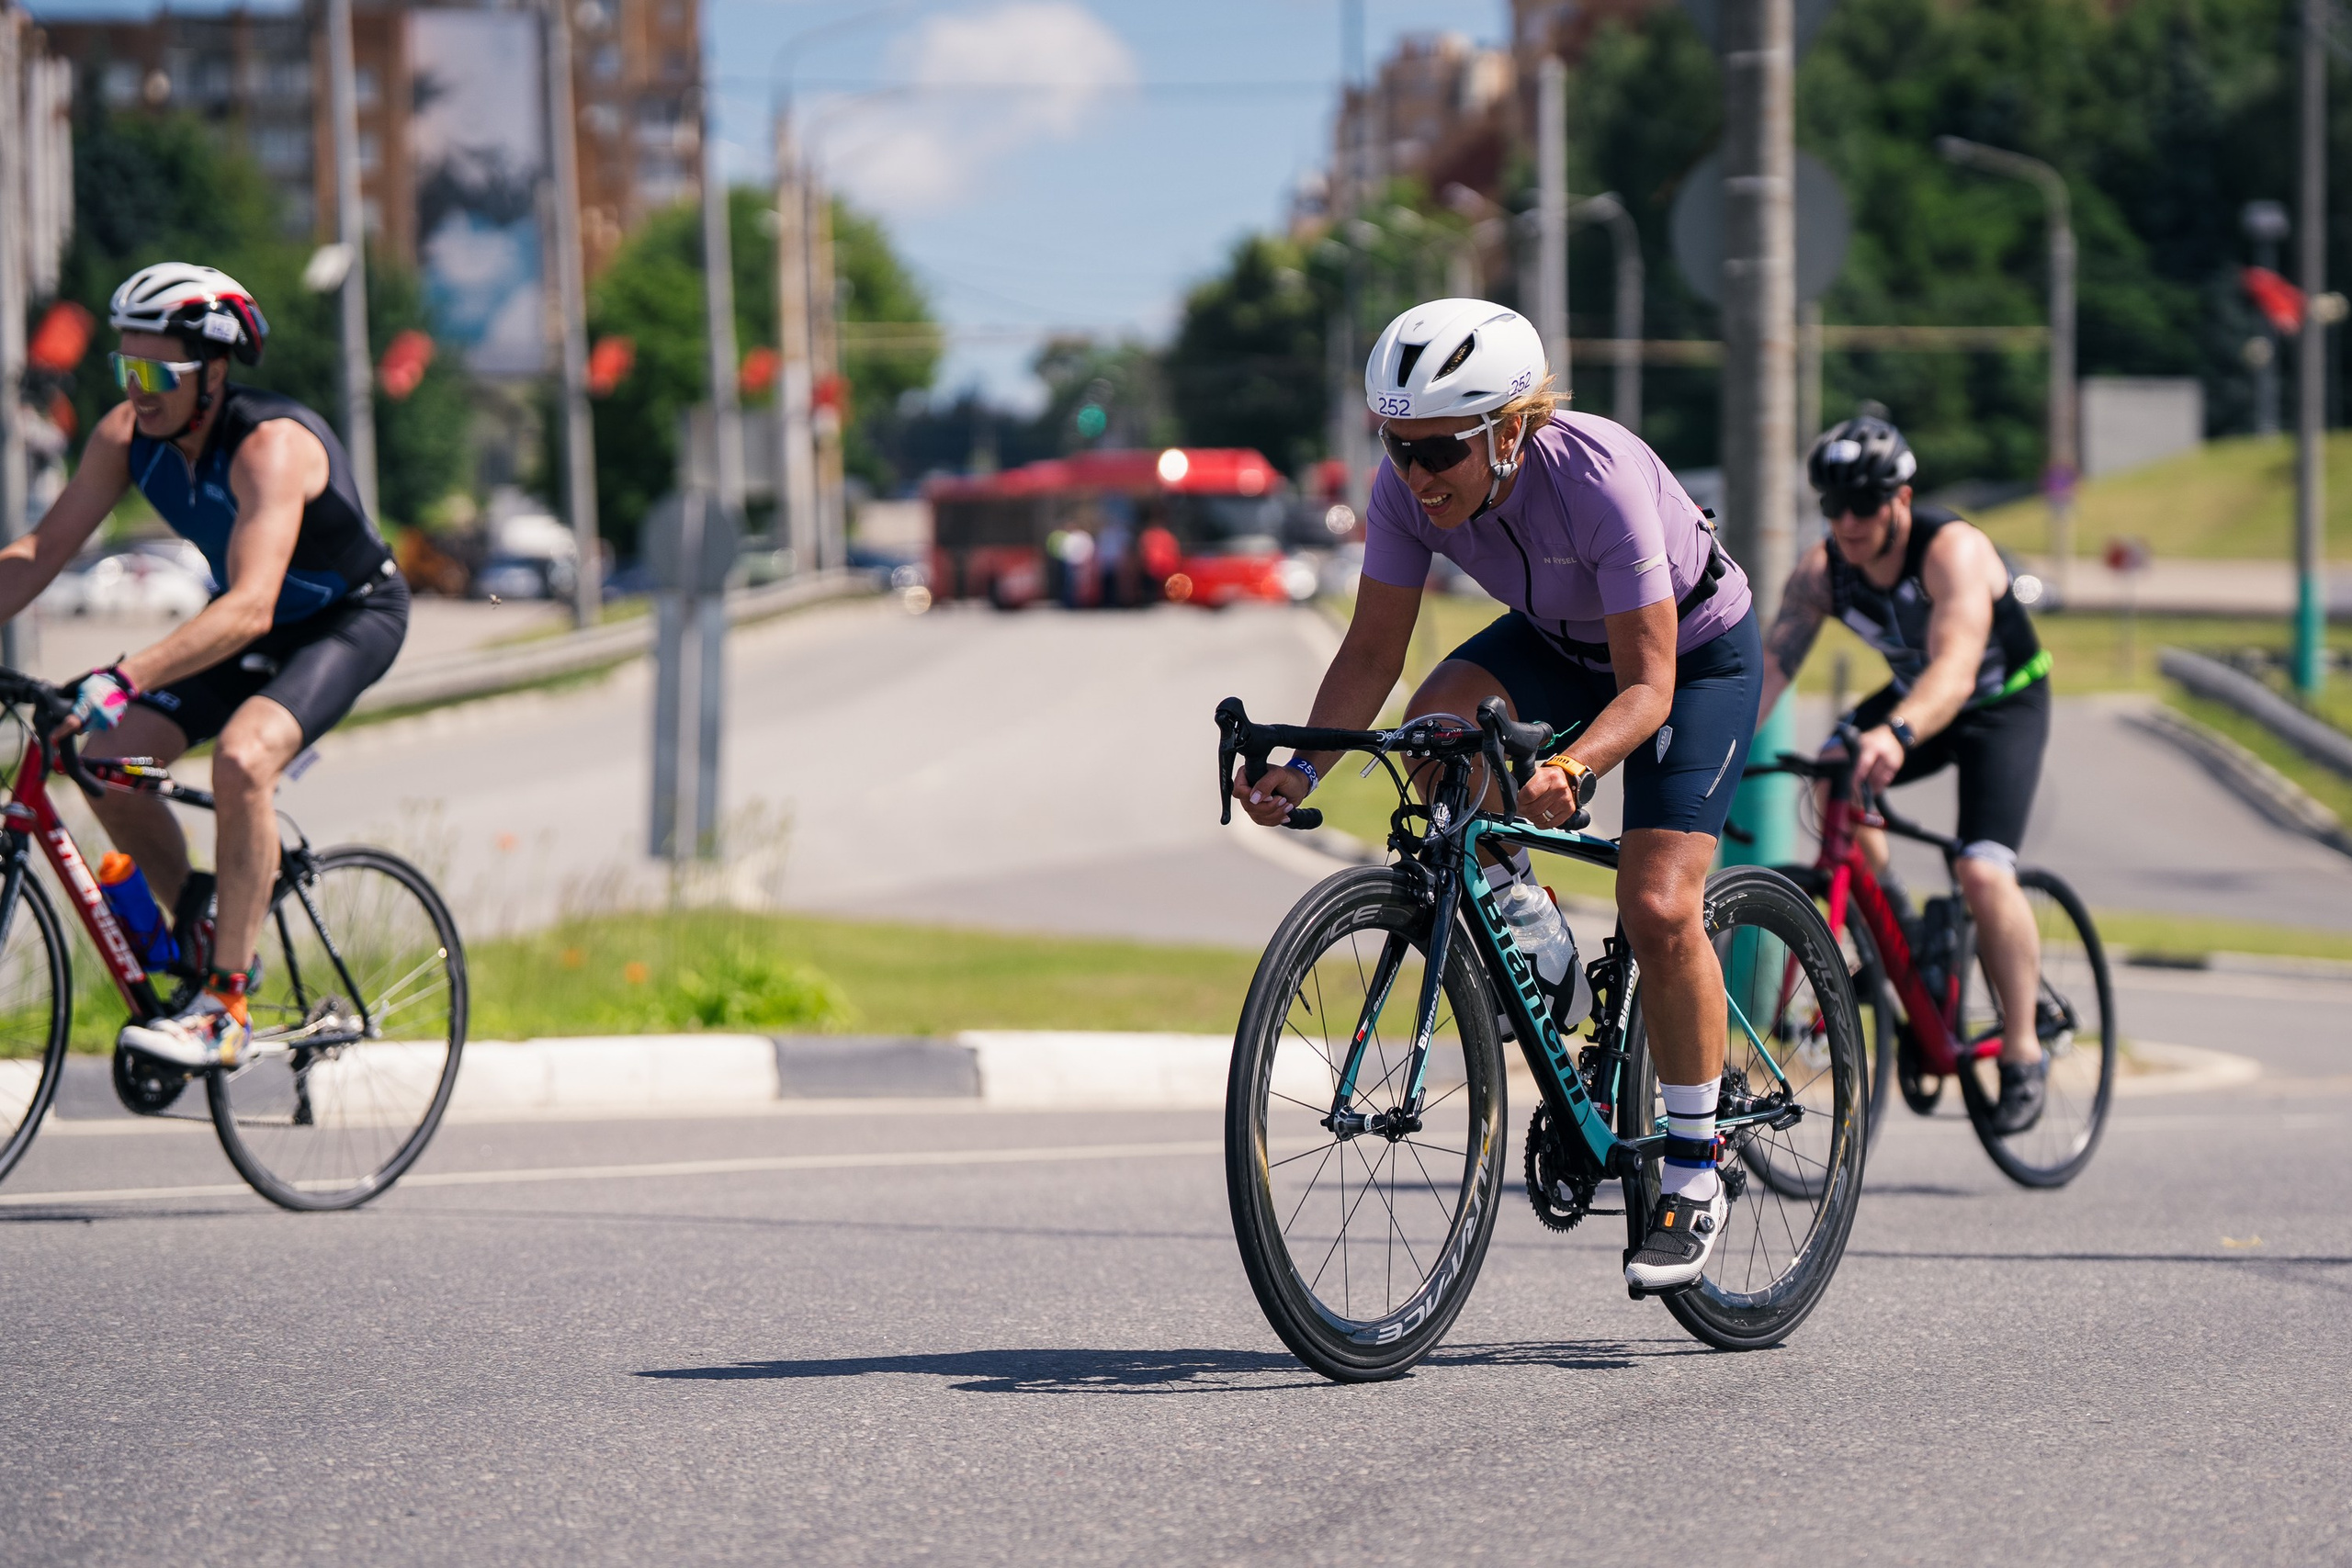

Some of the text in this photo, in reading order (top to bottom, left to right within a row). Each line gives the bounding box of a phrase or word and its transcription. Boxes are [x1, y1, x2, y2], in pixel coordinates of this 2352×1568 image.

[1378, 397, 1411, 416] 252
[1510, 371, 1532, 396] 252
[1553, 557, 1577, 565] RYSEL
[1297, 761, 1317, 782] 252
[47, 827, 146, 983] MERIDA
[1373, 962, 1398, 1012] Bianchi
[1476, 891, 1587, 1106] Bianchi
[1618, 958, 1638, 1031] Bianchi
[1418, 983, 1442, 1051] Bianchi
